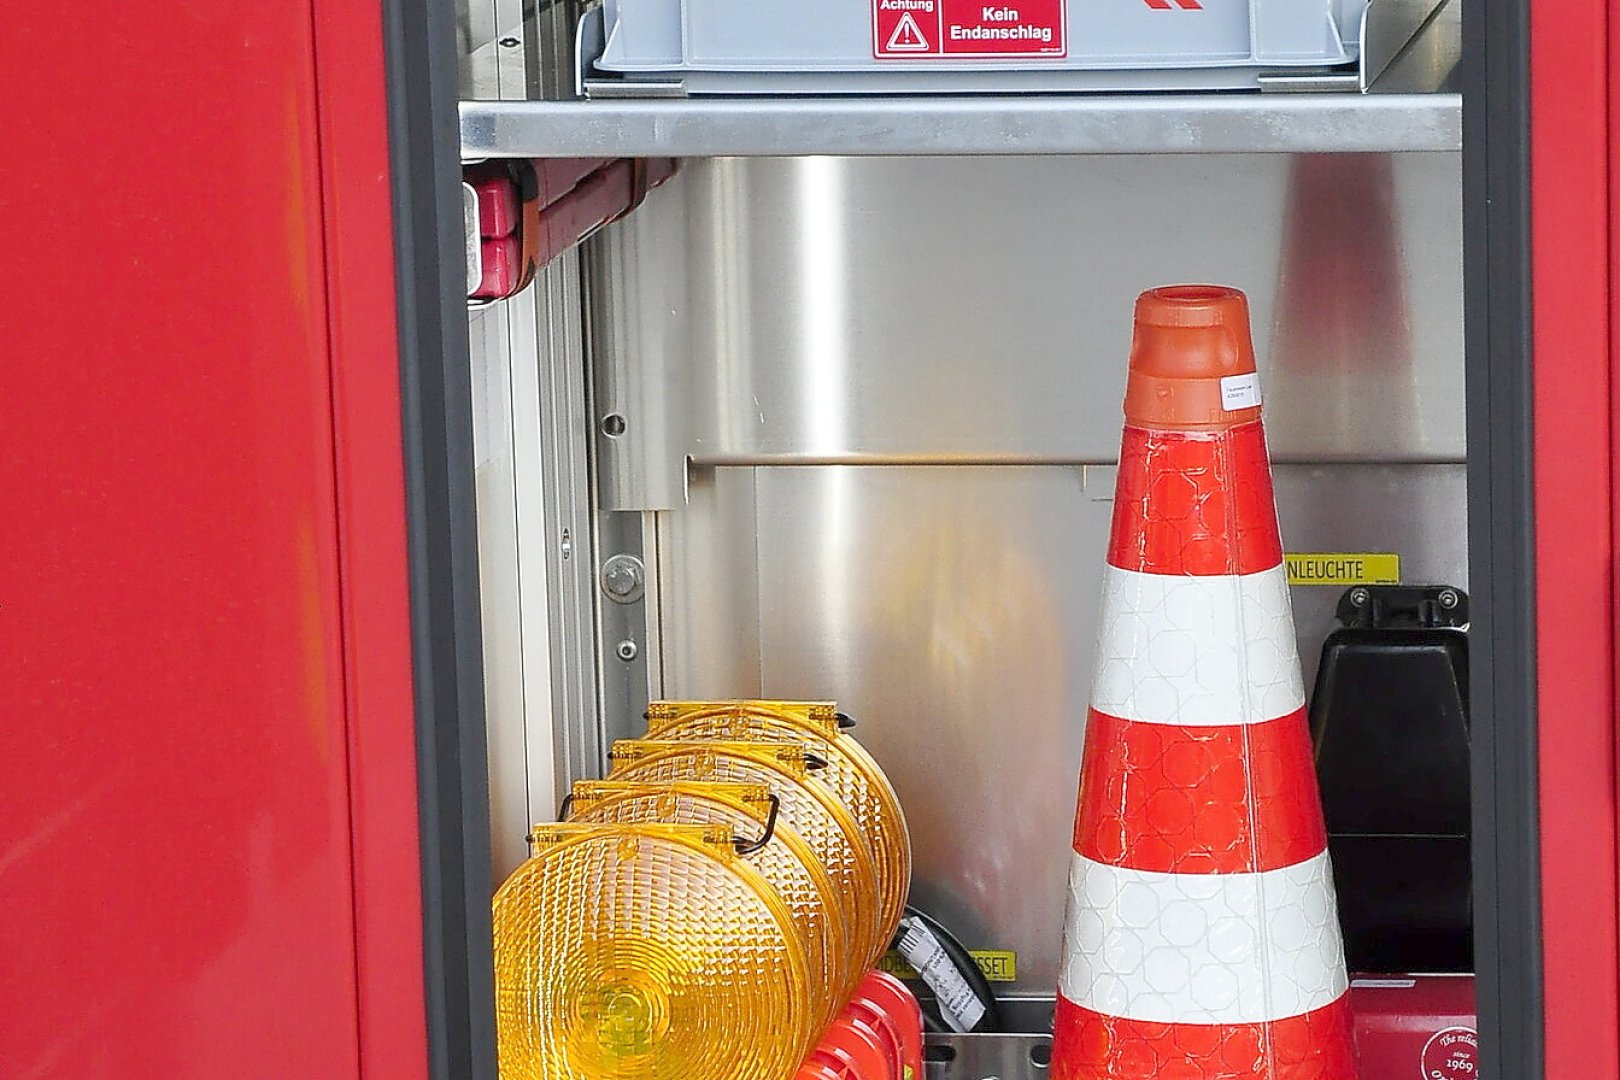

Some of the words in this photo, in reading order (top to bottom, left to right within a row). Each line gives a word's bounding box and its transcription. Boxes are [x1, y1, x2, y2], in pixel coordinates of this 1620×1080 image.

[880, 0, 934, 12] Achtung
[982, 6, 1019, 21] Kein
[950, 25, 1052, 42] Endanschlag
[1287, 560, 1363, 579] NLEUCHTE
[1446, 1059, 1473, 1073] 1969
